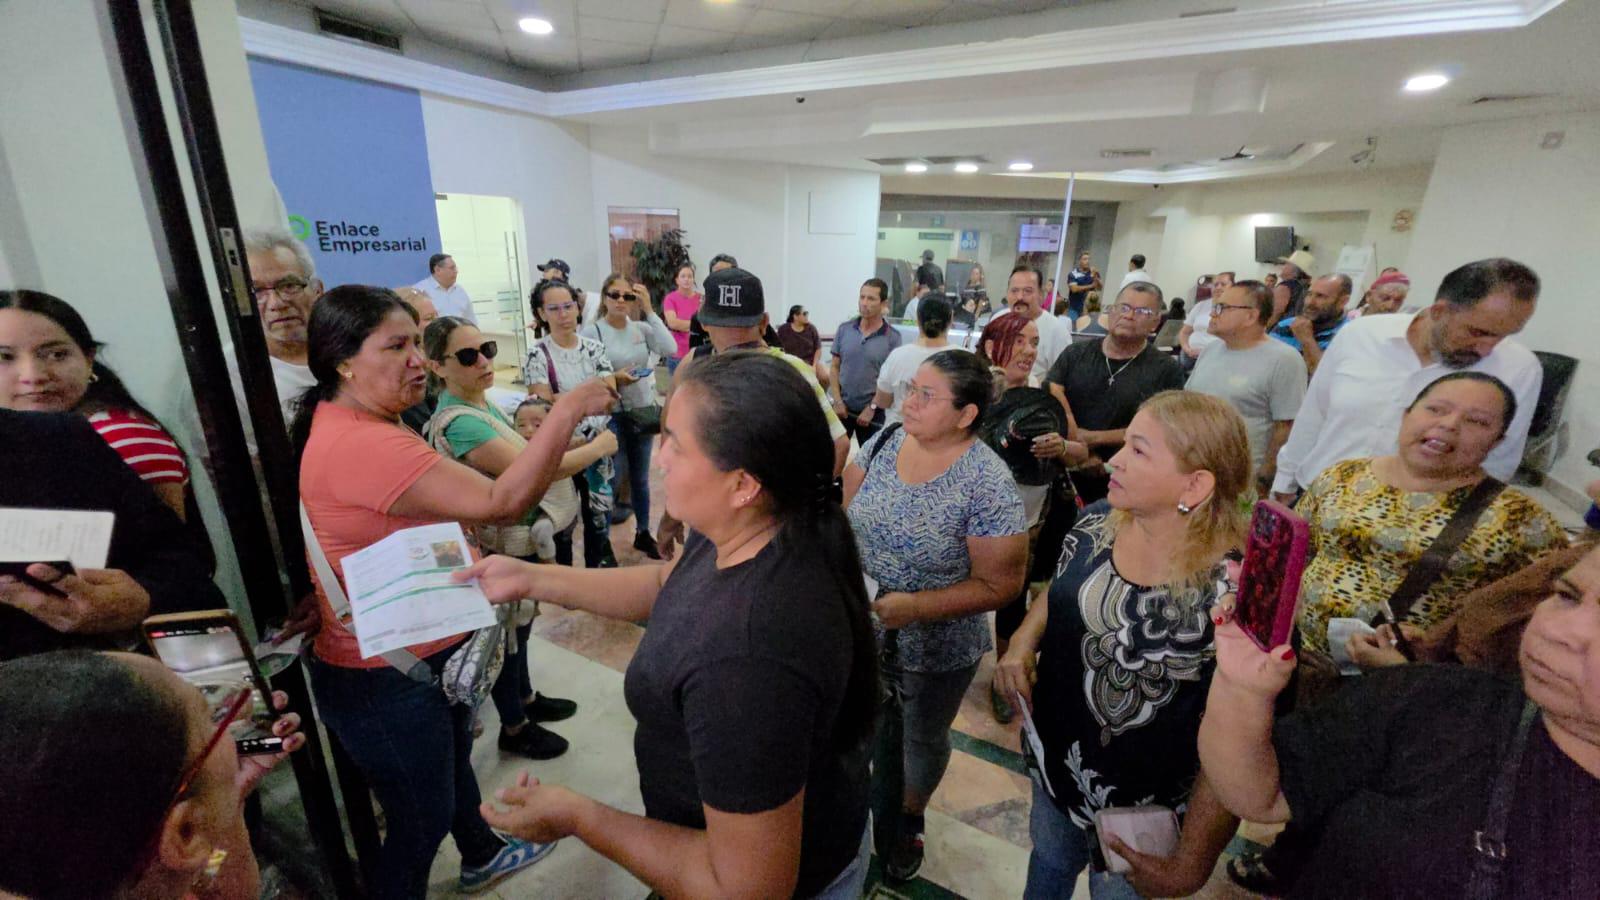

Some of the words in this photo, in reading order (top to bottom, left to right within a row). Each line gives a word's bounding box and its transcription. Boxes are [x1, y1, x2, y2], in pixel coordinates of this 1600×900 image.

[315, 220, 380, 236] Enlace
[319, 236, 427, 254] Empresarial
[718, 284, 742, 307] H
